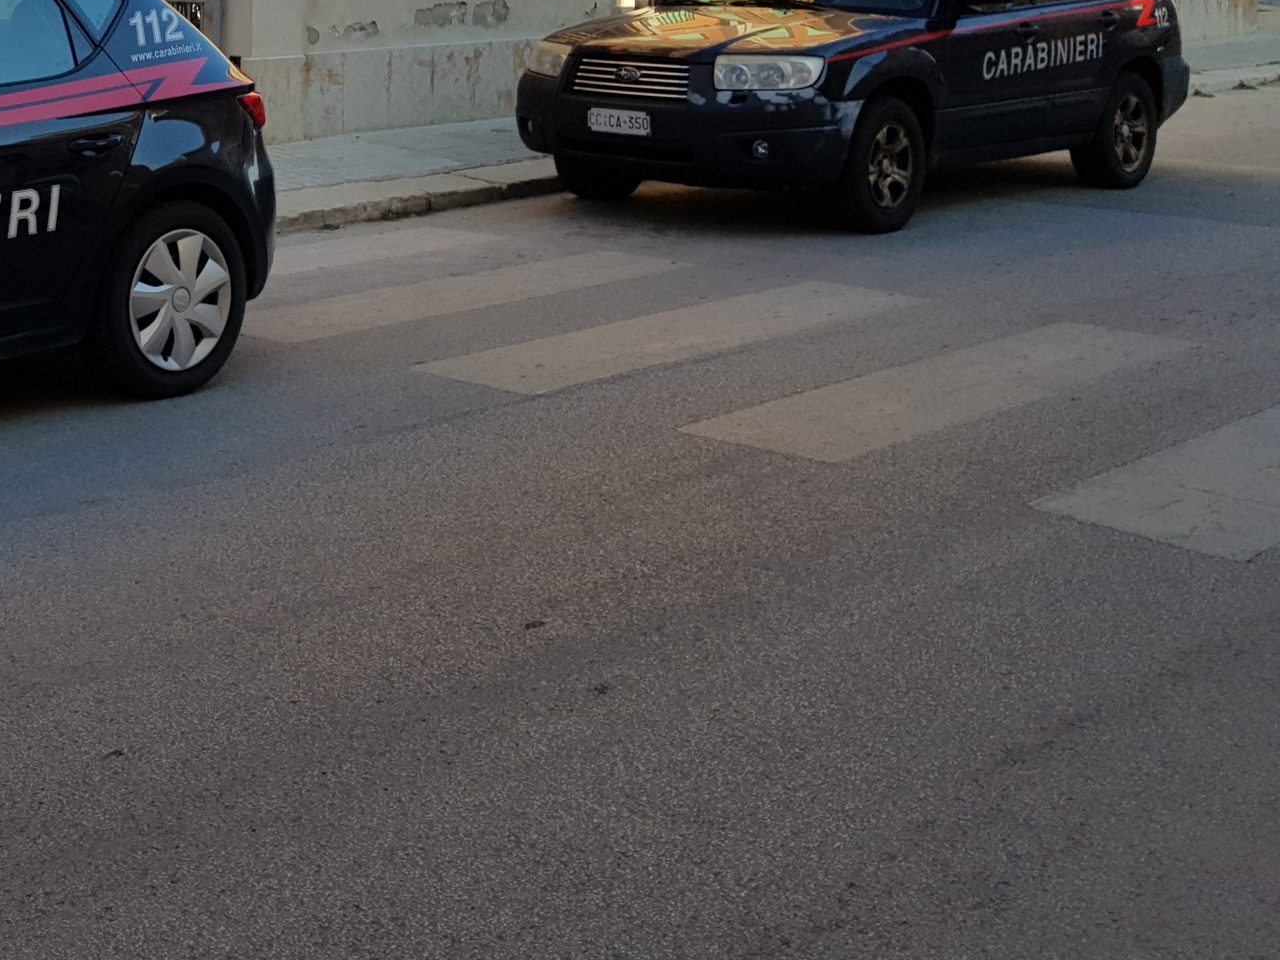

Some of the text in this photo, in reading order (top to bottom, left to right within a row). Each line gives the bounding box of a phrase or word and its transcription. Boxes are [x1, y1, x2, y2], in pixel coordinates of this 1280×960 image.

[129, 7, 184, 47] 112
[1154, 7, 1170, 27] 112
[131, 42, 202, 62] www.carabinieri.it
[982, 32, 1103, 80] CARABINIERI
